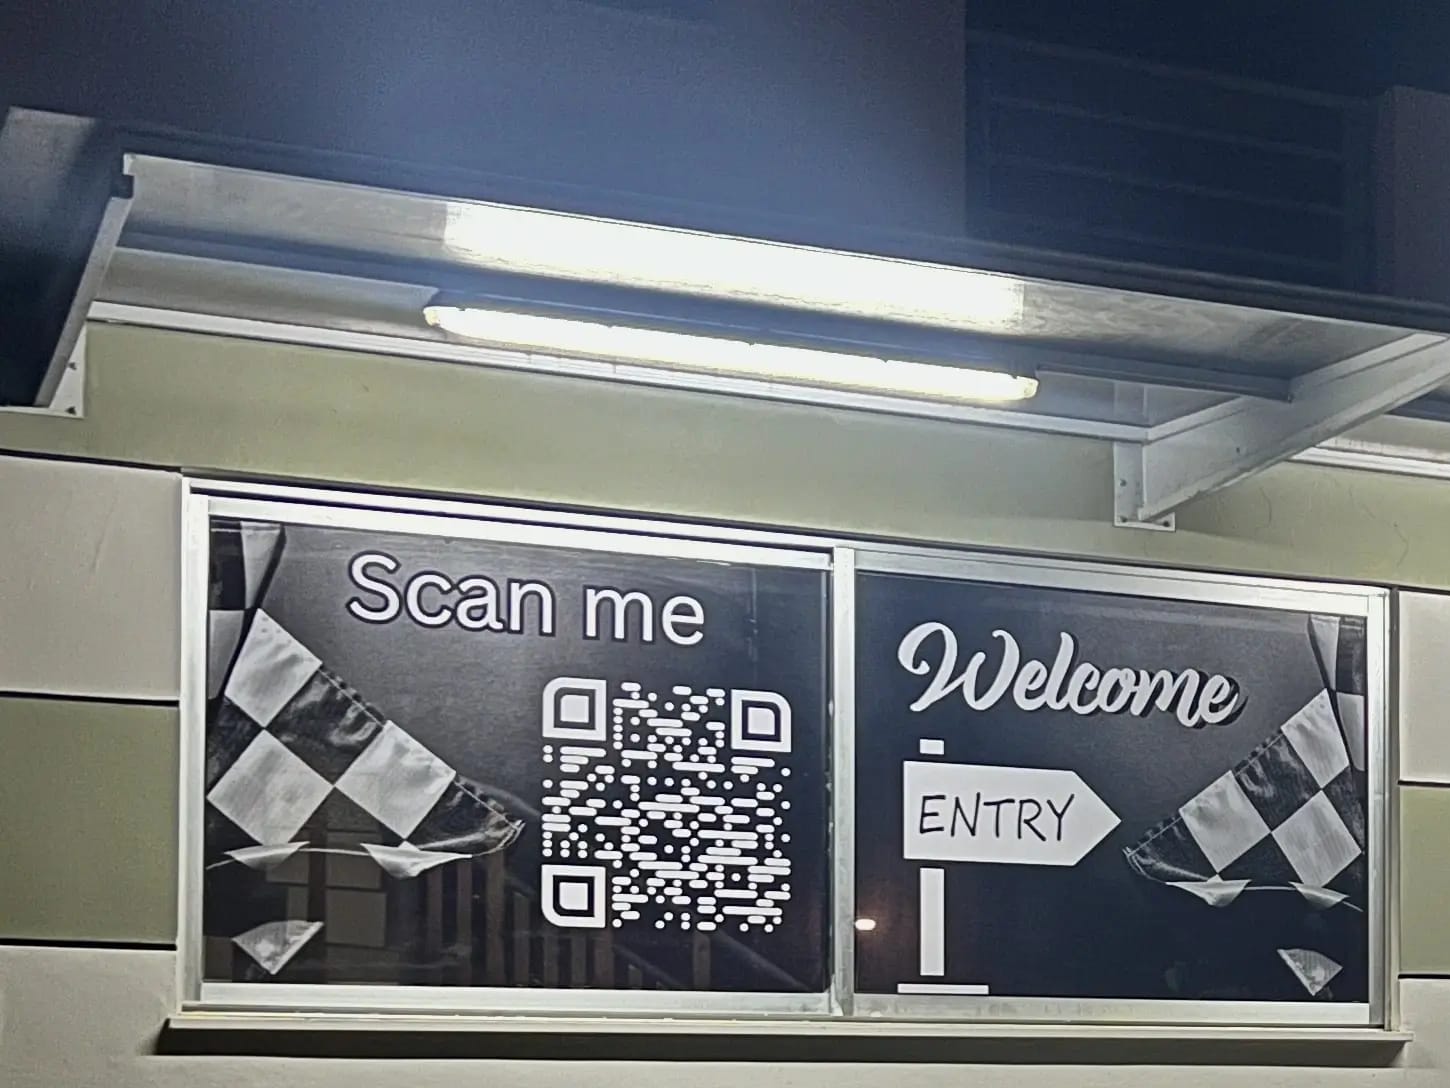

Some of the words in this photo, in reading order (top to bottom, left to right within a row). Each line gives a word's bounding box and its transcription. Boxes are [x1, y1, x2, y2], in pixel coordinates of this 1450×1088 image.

[347, 552, 554, 636] Scan
[584, 587, 705, 646] me
[897, 621, 1242, 728] Welcome
[918, 792, 1075, 842] ENTRY
